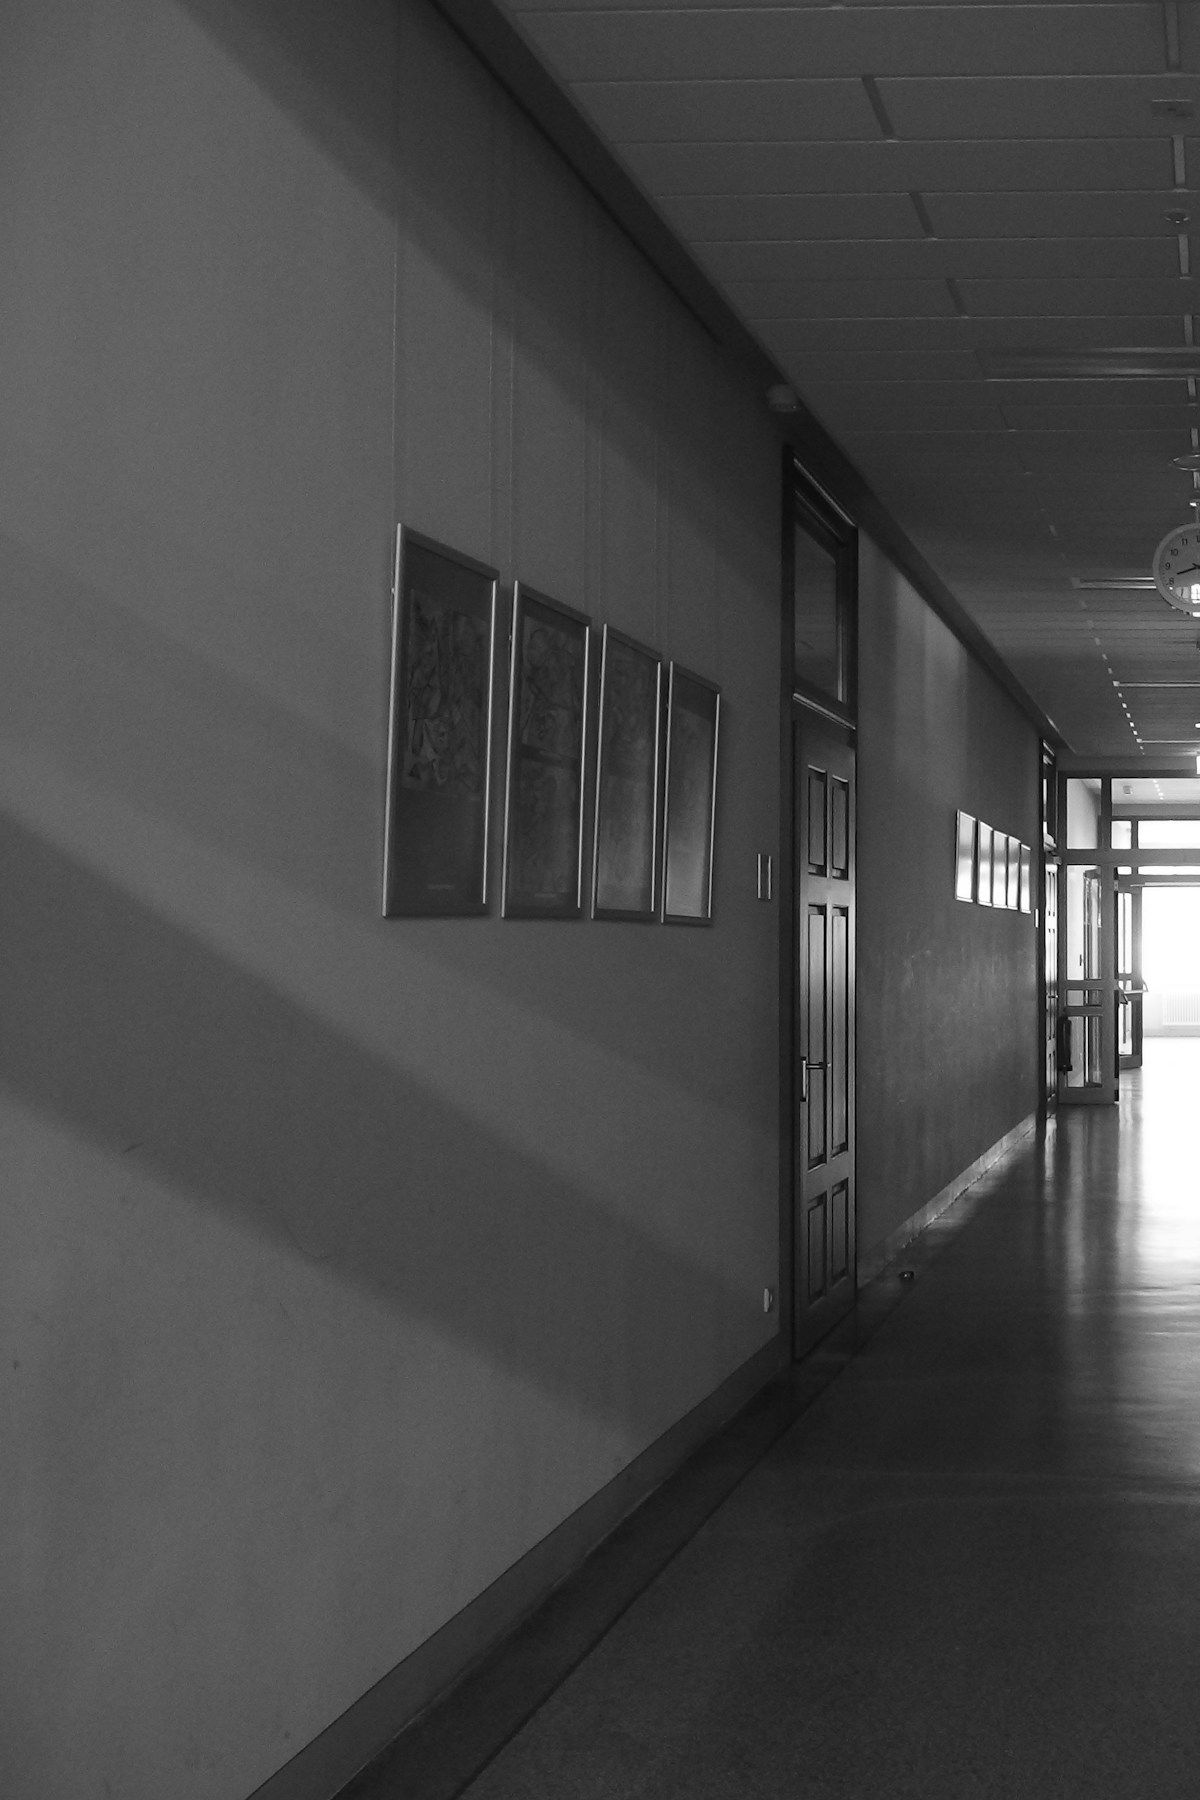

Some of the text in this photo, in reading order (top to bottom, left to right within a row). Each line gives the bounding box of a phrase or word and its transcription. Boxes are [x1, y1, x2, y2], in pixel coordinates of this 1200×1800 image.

[1181, 538, 1188, 546] 11
[1170, 548, 1179, 556] 10
[1165, 562, 1171, 570] 9
